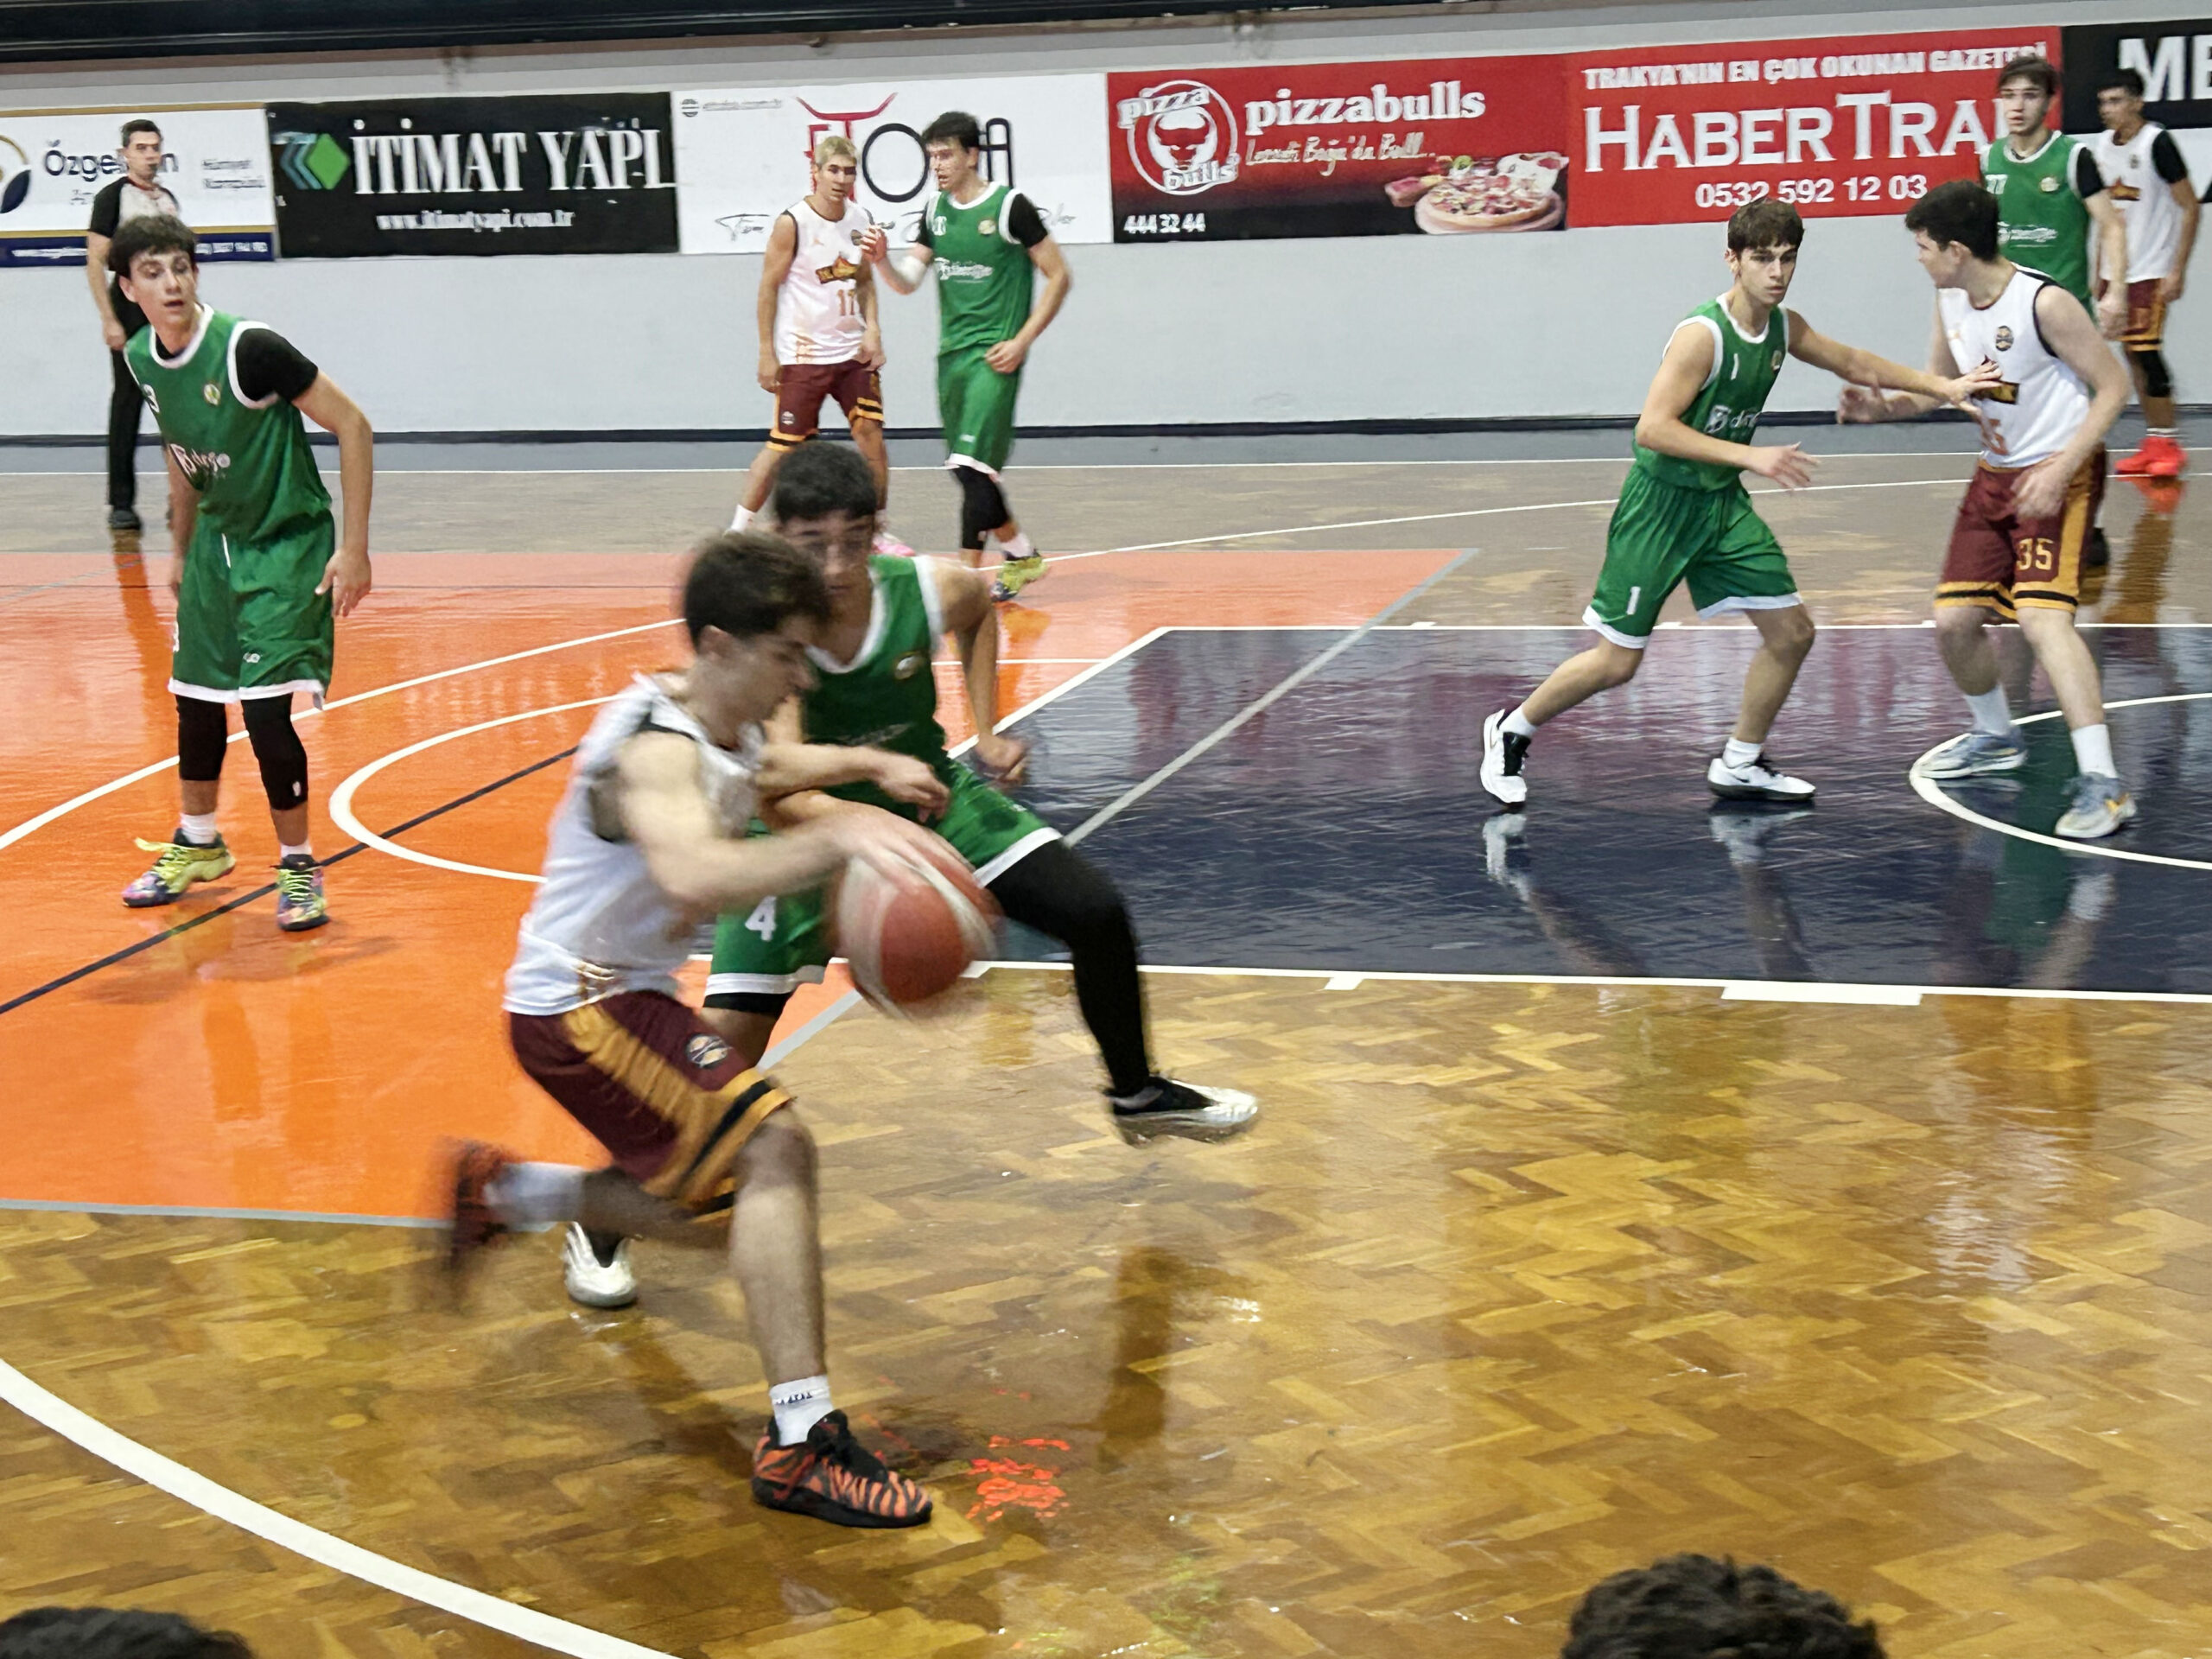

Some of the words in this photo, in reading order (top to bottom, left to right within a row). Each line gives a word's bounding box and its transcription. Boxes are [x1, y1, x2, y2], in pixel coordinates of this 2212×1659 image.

[1580, 62, 1725, 90] TRAKYA'NIN
[1729, 60, 1759, 82] EN
[1764, 57, 1817, 85] ÇOK
[1821, 52, 1926, 78] OKUNAN
[1117, 87, 1210, 129] pizza
[1245, 80, 1486, 136] pizzabulls
[350, 118, 526, 194] İTİMAT
[1164, 156, 1239, 191] bulls
[1695, 181, 1770, 207] 0532
[1777, 178, 1834, 204] 592
[1842, 176, 1880, 201] 12
[1889, 174, 1928, 200] 03
[1124, 214, 1158, 234] 444
[1159, 213, 1180, 233] 32
[1181, 213, 1206, 232] 44
[1730, 353, 1739, 380] 1
[2016, 537, 2053, 571] 35
[1626, 586, 1641, 615] 1
[745, 895, 777, 942] 4
